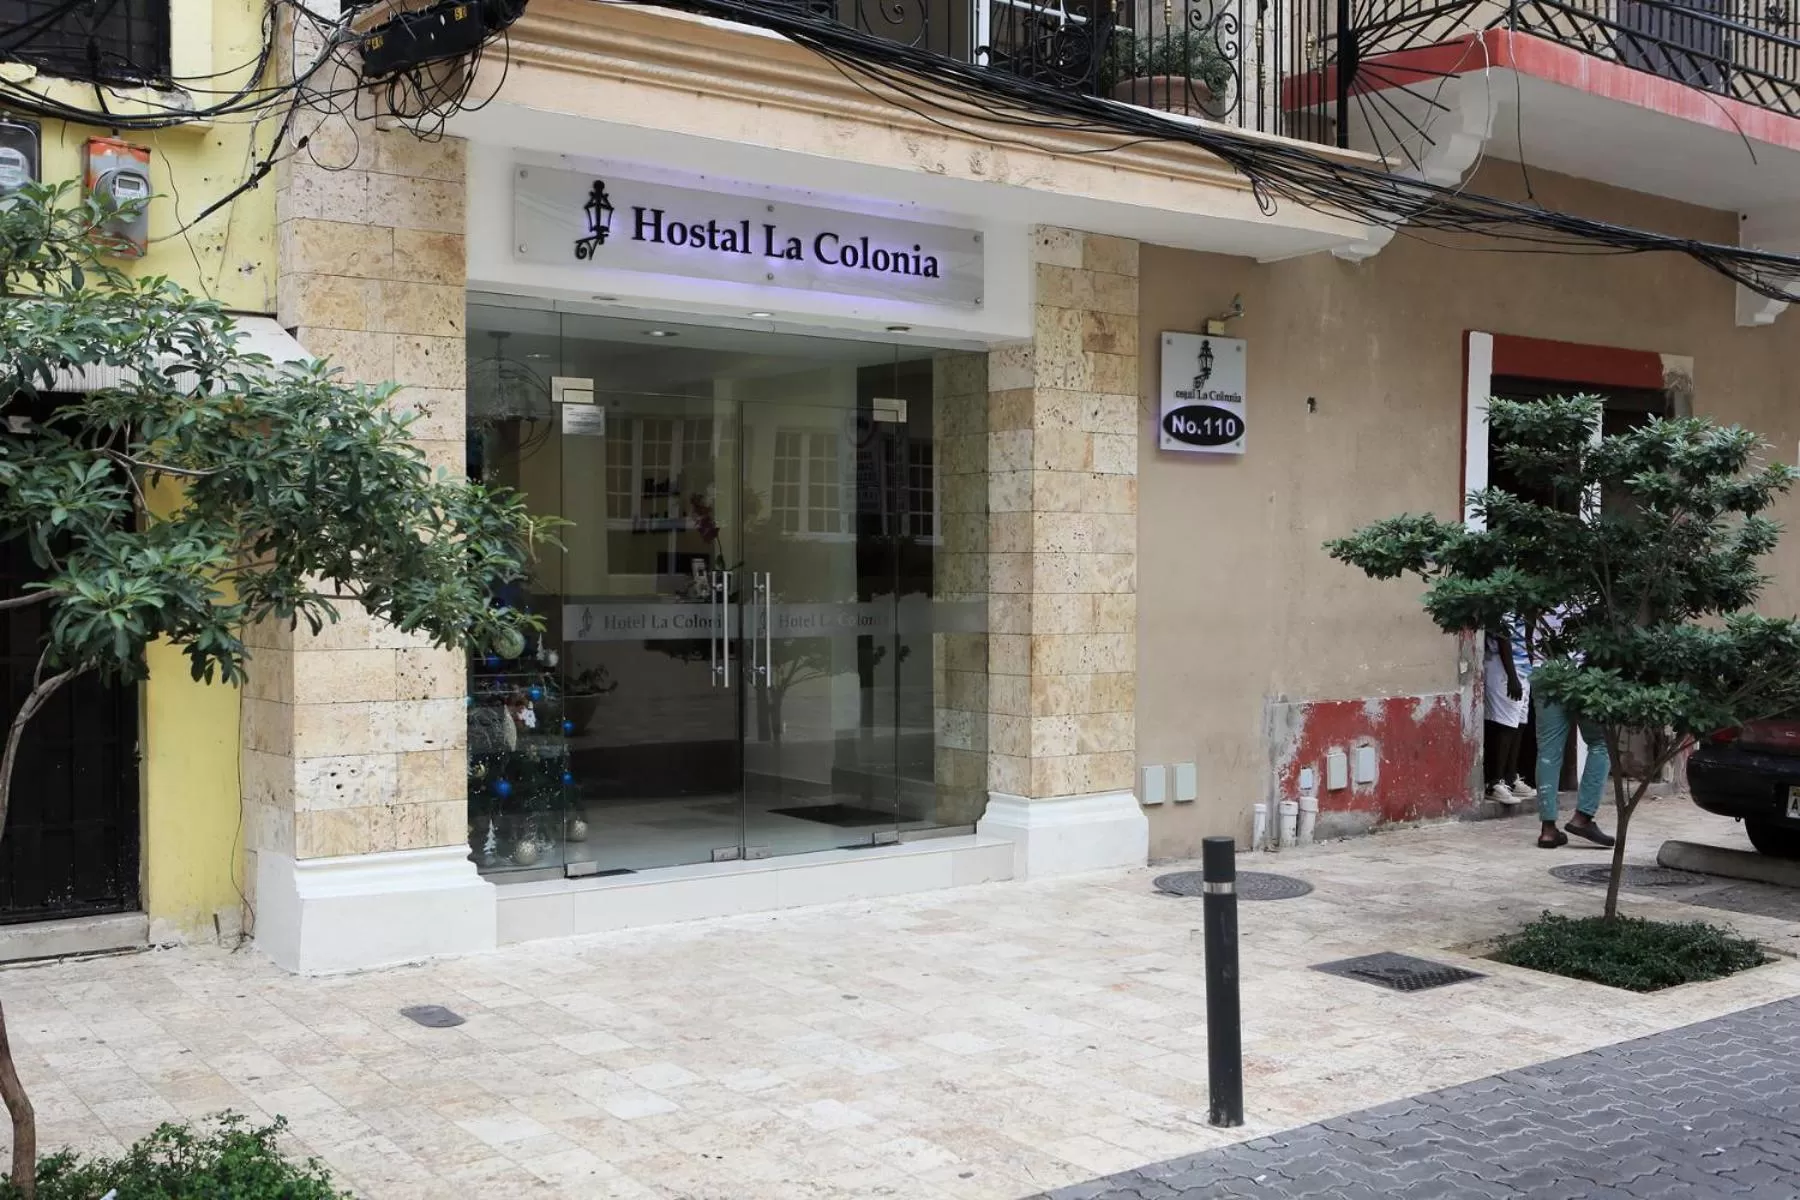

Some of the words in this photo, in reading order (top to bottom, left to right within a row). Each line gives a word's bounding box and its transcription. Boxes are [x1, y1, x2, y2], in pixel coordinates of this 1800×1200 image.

[631, 206, 752, 255] Hostal
[762, 224, 804, 262] La
[813, 231, 940, 279] Colonia
[604, 613, 646, 630] Hotel
[651, 614, 669, 629] La
